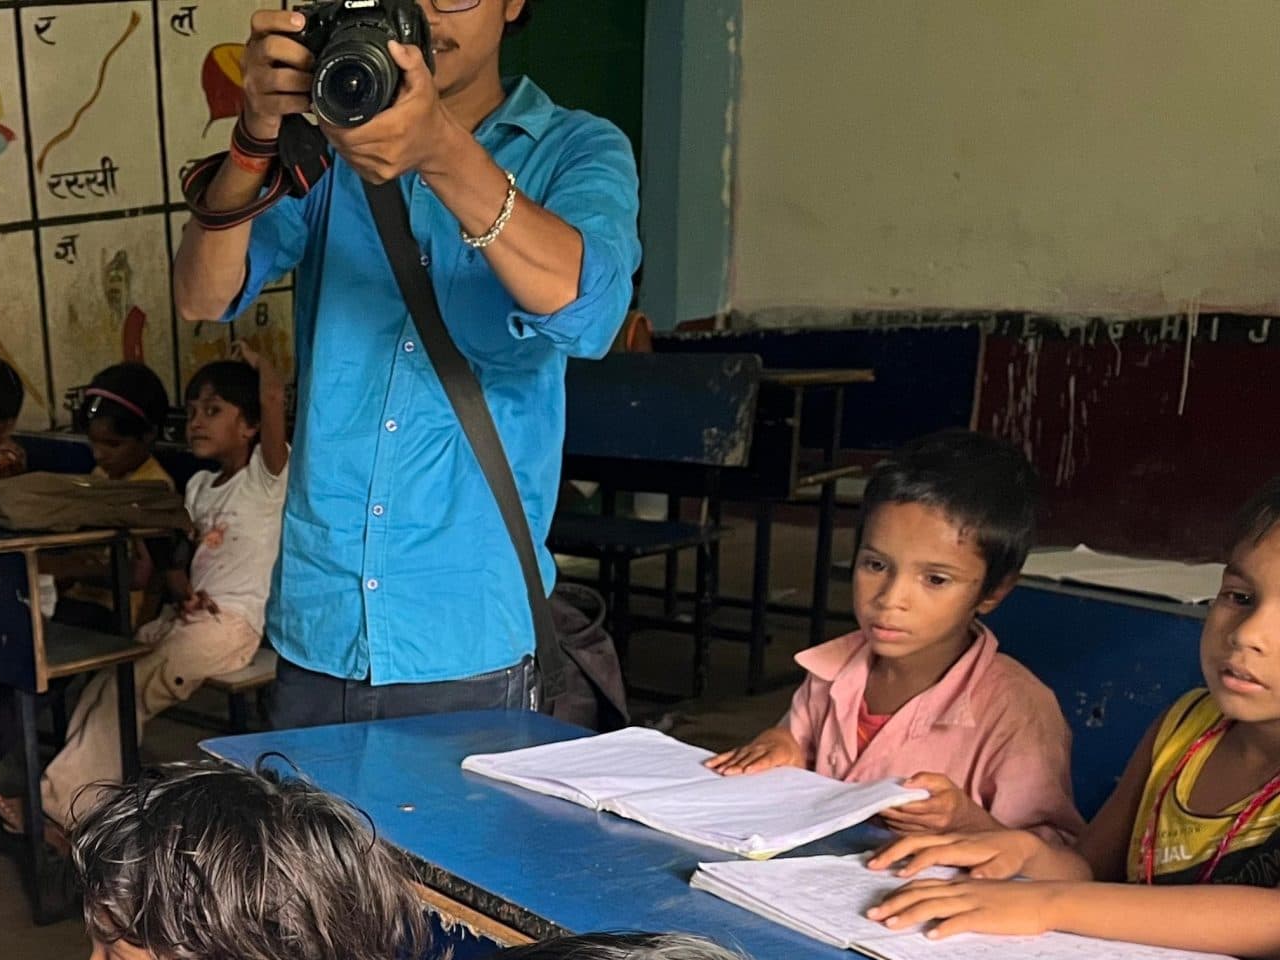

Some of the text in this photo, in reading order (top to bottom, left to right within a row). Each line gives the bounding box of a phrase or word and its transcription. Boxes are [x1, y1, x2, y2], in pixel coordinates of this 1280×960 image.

[34, 16, 56, 45] र
[171, 6, 198, 36] ल
[1160, 316, 1180, 340] H
[1249, 318, 1271, 343] J
